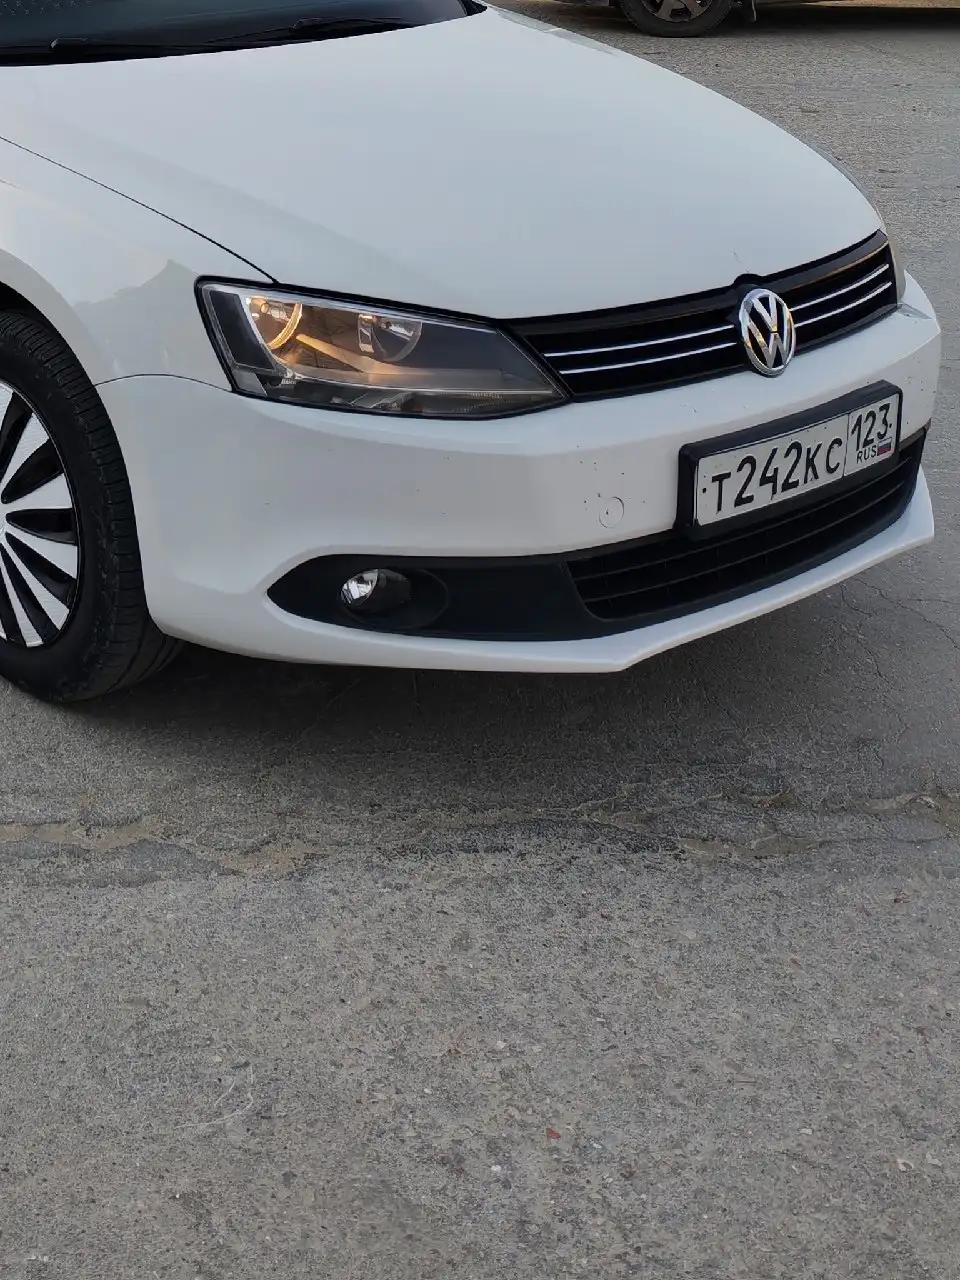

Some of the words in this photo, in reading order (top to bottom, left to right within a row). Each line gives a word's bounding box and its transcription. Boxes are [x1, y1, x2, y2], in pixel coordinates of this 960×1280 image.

[711, 437, 843, 515] Т242КС
[851, 402, 890, 452] 123
[856, 444, 878, 465] RUS
